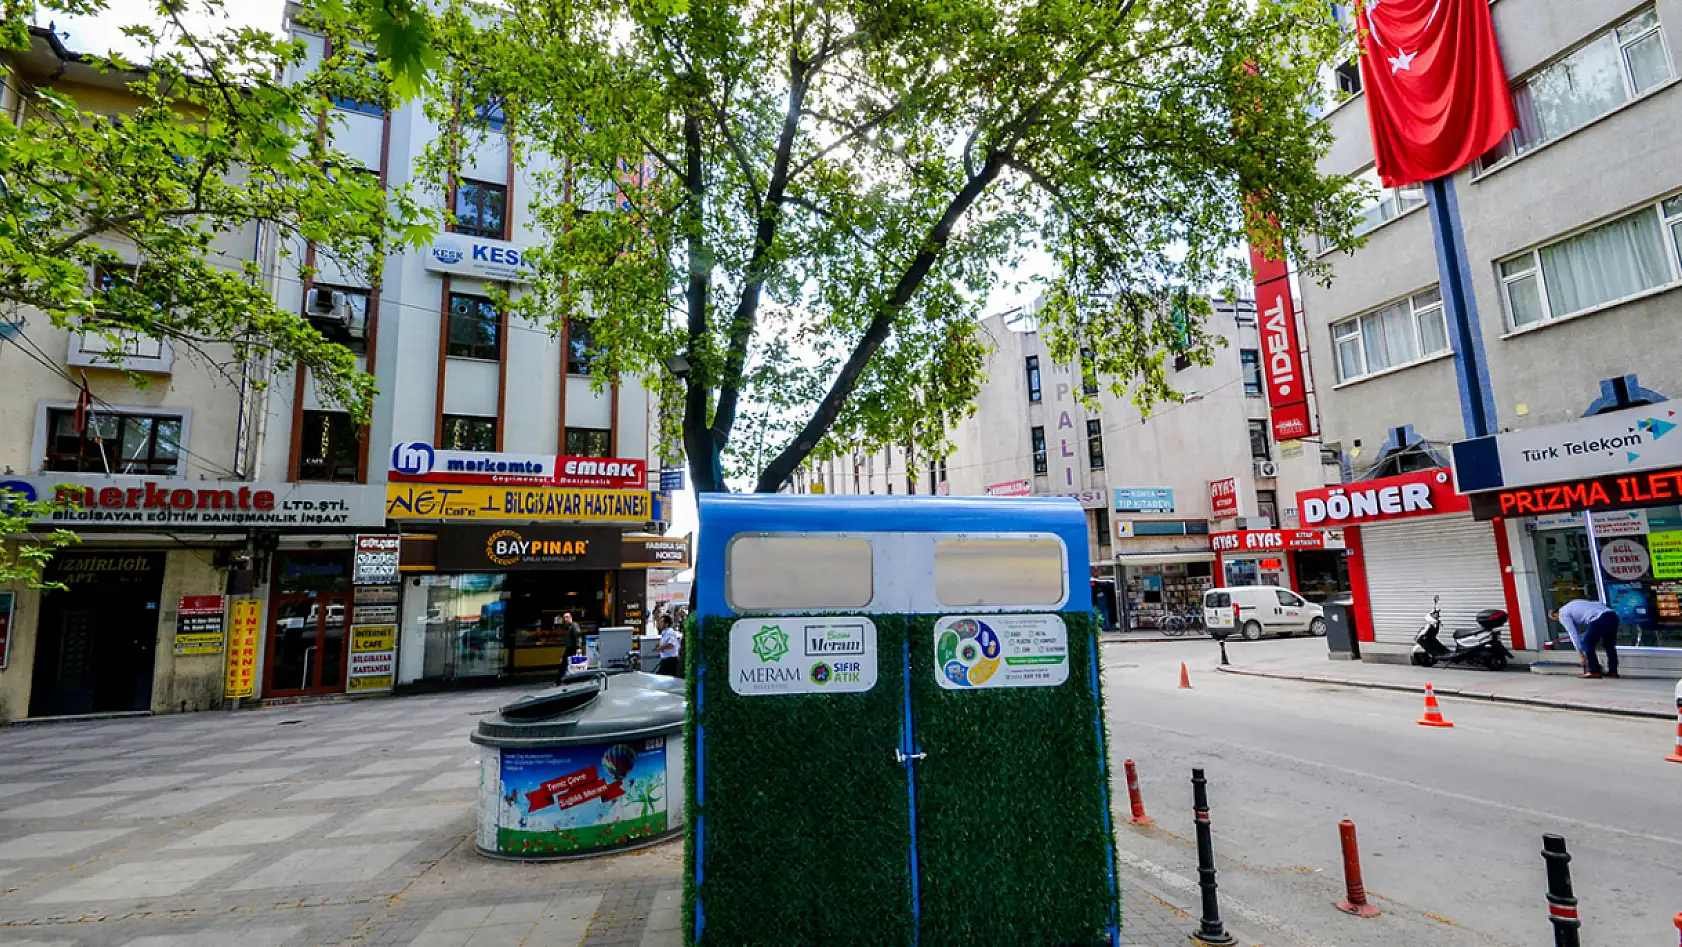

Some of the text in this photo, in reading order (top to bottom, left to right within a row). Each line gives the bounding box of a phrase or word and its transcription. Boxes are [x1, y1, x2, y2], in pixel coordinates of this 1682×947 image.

[432, 248, 464, 260] KESK
[1264, 294, 1295, 384] IDEAL
[1521, 433, 1642, 462] Türk Telekom
[447, 458, 543, 473] merkomte
[564, 460, 638, 477] EMLAK
[1130, 489, 1157, 498] KONYA
[1211, 479, 1236, 497] AYAS
[387, 488, 463, 516] NET
[1119, 500, 1132, 508] TIP
[1303, 483, 1433, 523] DÖNER
[1499, 481, 1611, 515] PRIZMA
[53, 510, 349, 524] BİLGİSAYAR EĞİTİM DANIŞMANLIK İNŞAAT
[1213, 532, 1283, 550] AYAS AYAS
[811, 637, 860, 651] Meram
[739, 667, 801, 683] MERAM
[833, 662, 860, 673] SIFIR
[834, 673, 860, 682] ATIK
